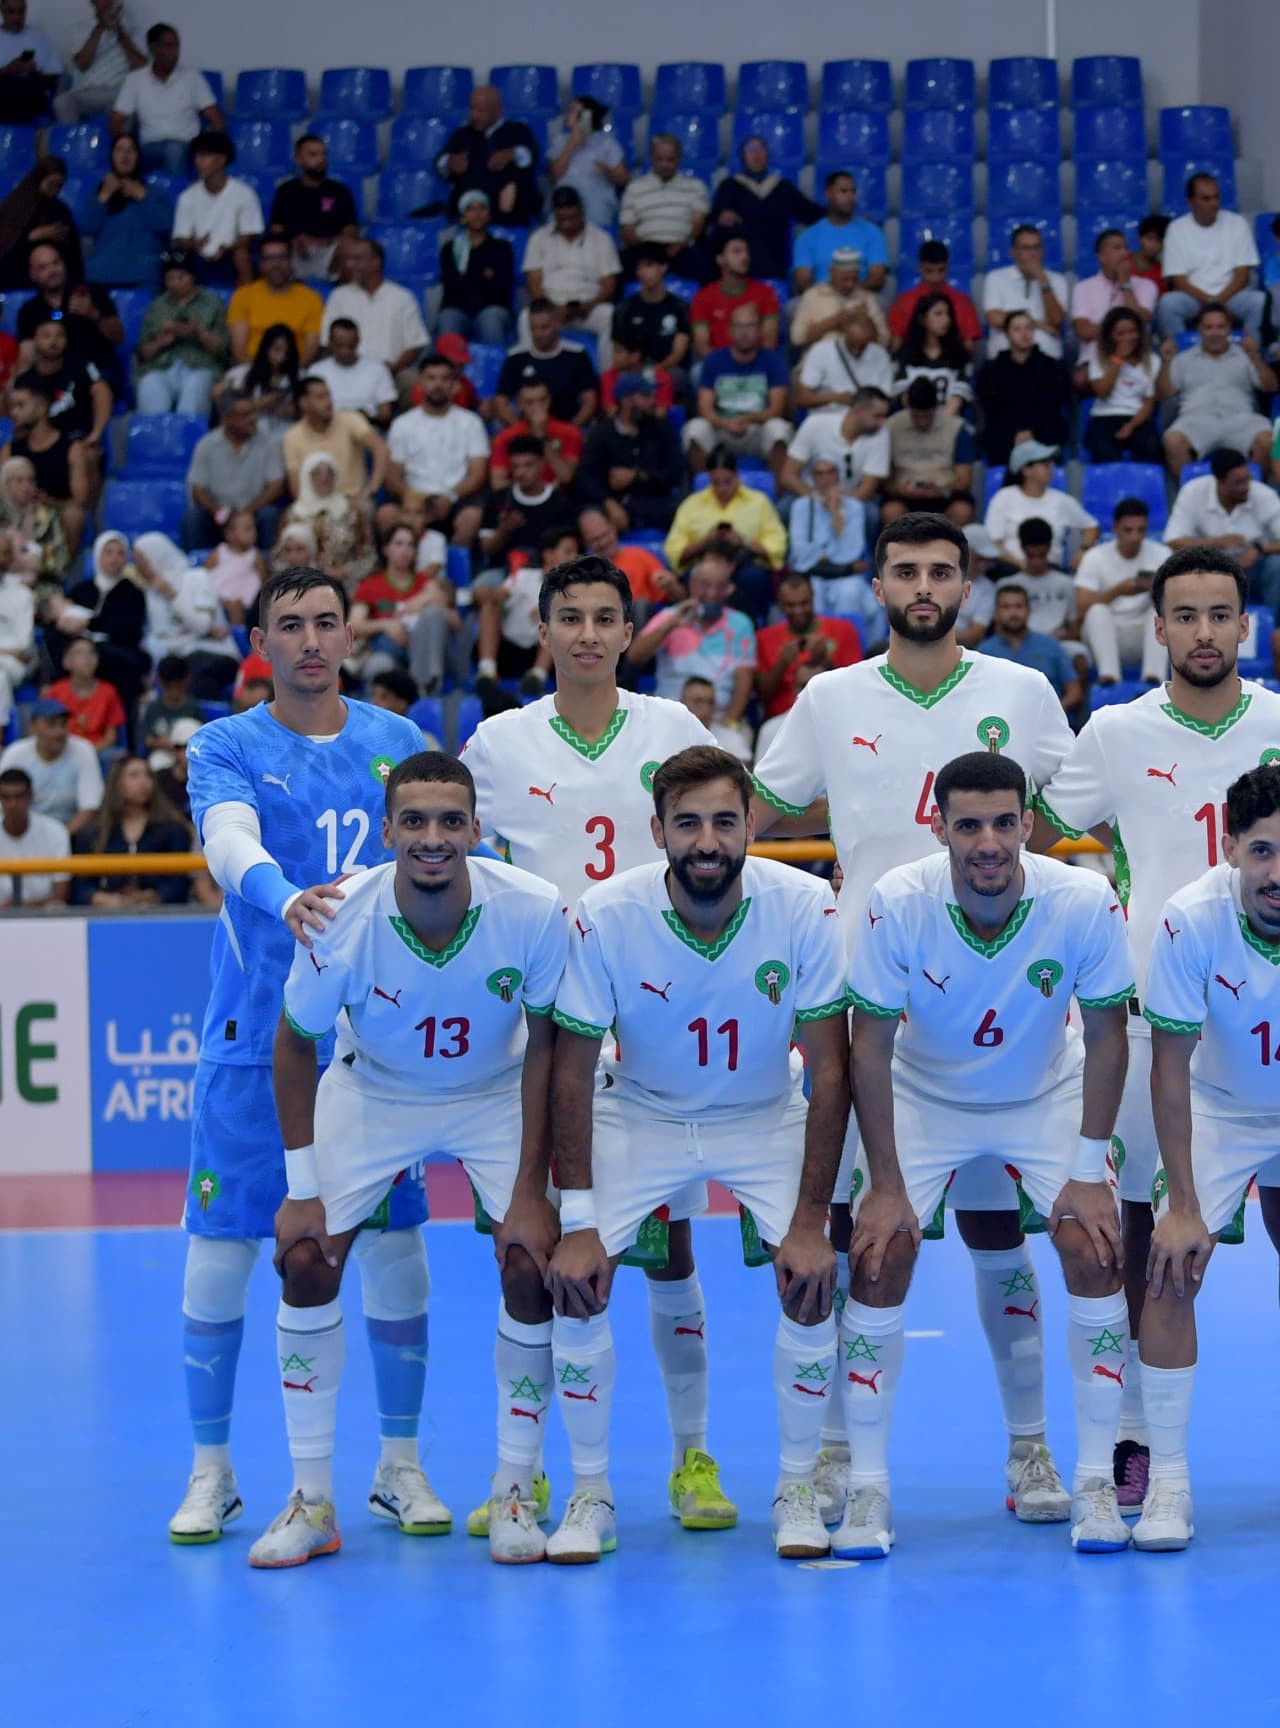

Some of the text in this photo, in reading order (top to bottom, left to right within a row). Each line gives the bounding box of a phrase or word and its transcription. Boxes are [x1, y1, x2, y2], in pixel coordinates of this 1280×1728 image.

[315, 808, 370, 875] 12
[584, 815, 616, 881] 3
[1194, 802, 1229, 868] 1
[414, 1016, 471, 1059] 13
[687, 1016, 739, 1071] 11
[974, 1008, 1004, 1047] 6
